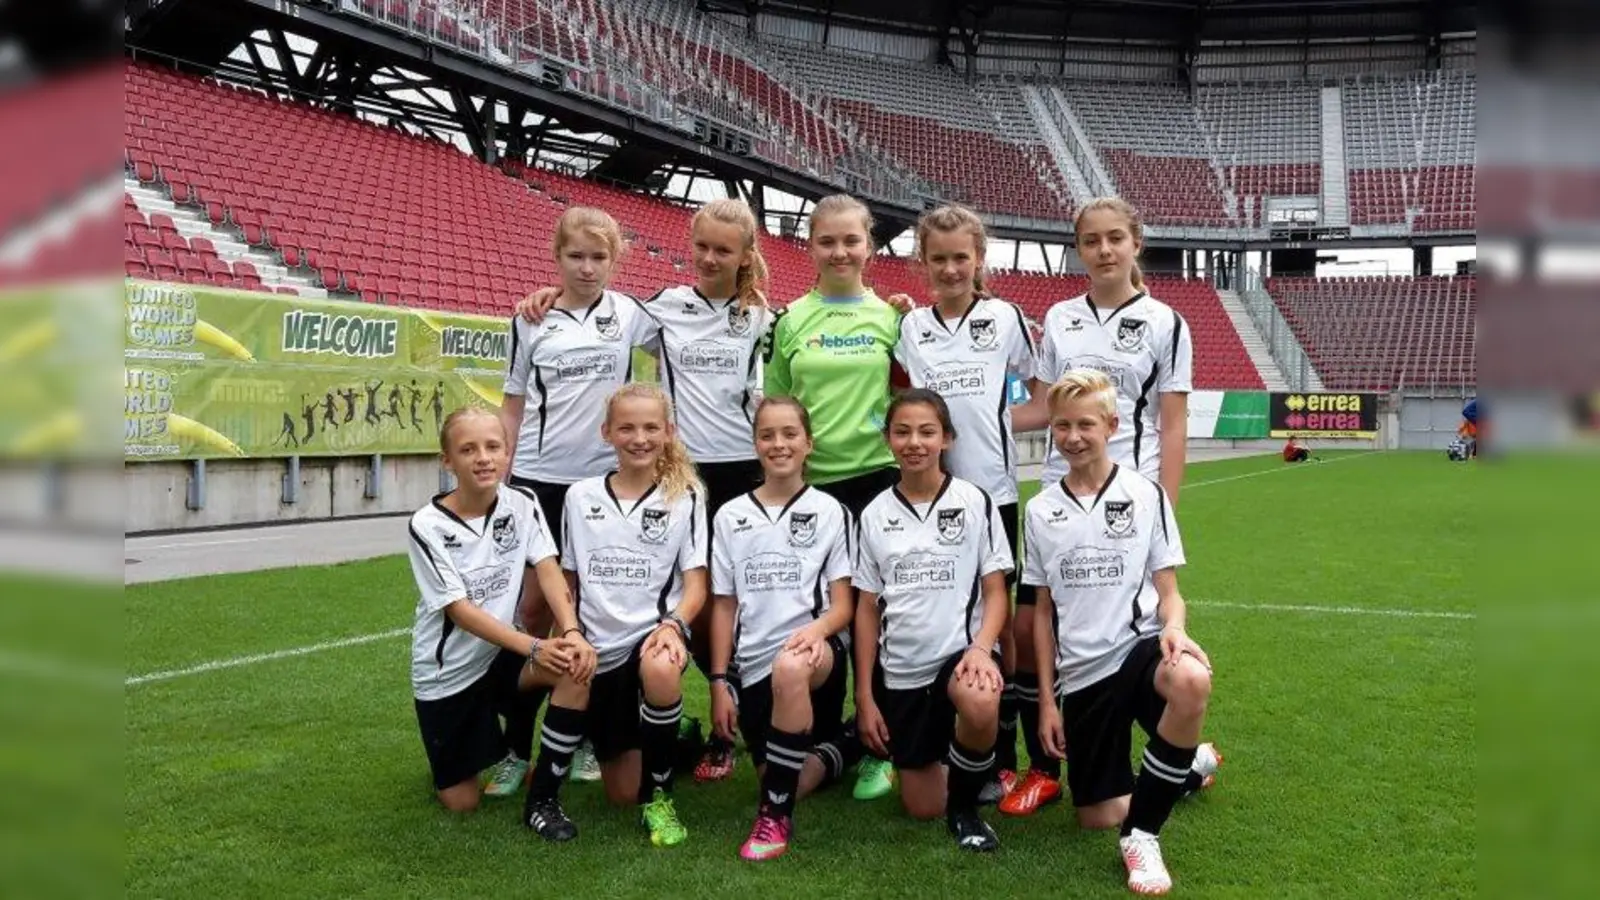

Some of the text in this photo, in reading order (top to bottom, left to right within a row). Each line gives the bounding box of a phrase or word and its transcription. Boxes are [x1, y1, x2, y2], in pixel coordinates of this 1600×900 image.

[129, 285, 196, 310] UNITED
[129, 304, 196, 326] WORLD
[130, 322, 195, 347] GAMES
[282, 309, 397, 358] WELCOME
[440, 325, 508, 361] WELCOM
[680, 352, 739, 369] Isartal
[925, 373, 985, 391] Isartal
[1306, 394, 1361, 412] errea
[1306, 413, 1361, 430] errea
[590, 553, 651, 565] Autosalon
[1060, 555, 1124, 567] Autosalon
[588, 563, 651, 578] Isartal
[745, 569, 802, 584] Isartal
[894, 567, 955, 584] Isartal
[1060, 563, 1124, 580] Isartal
